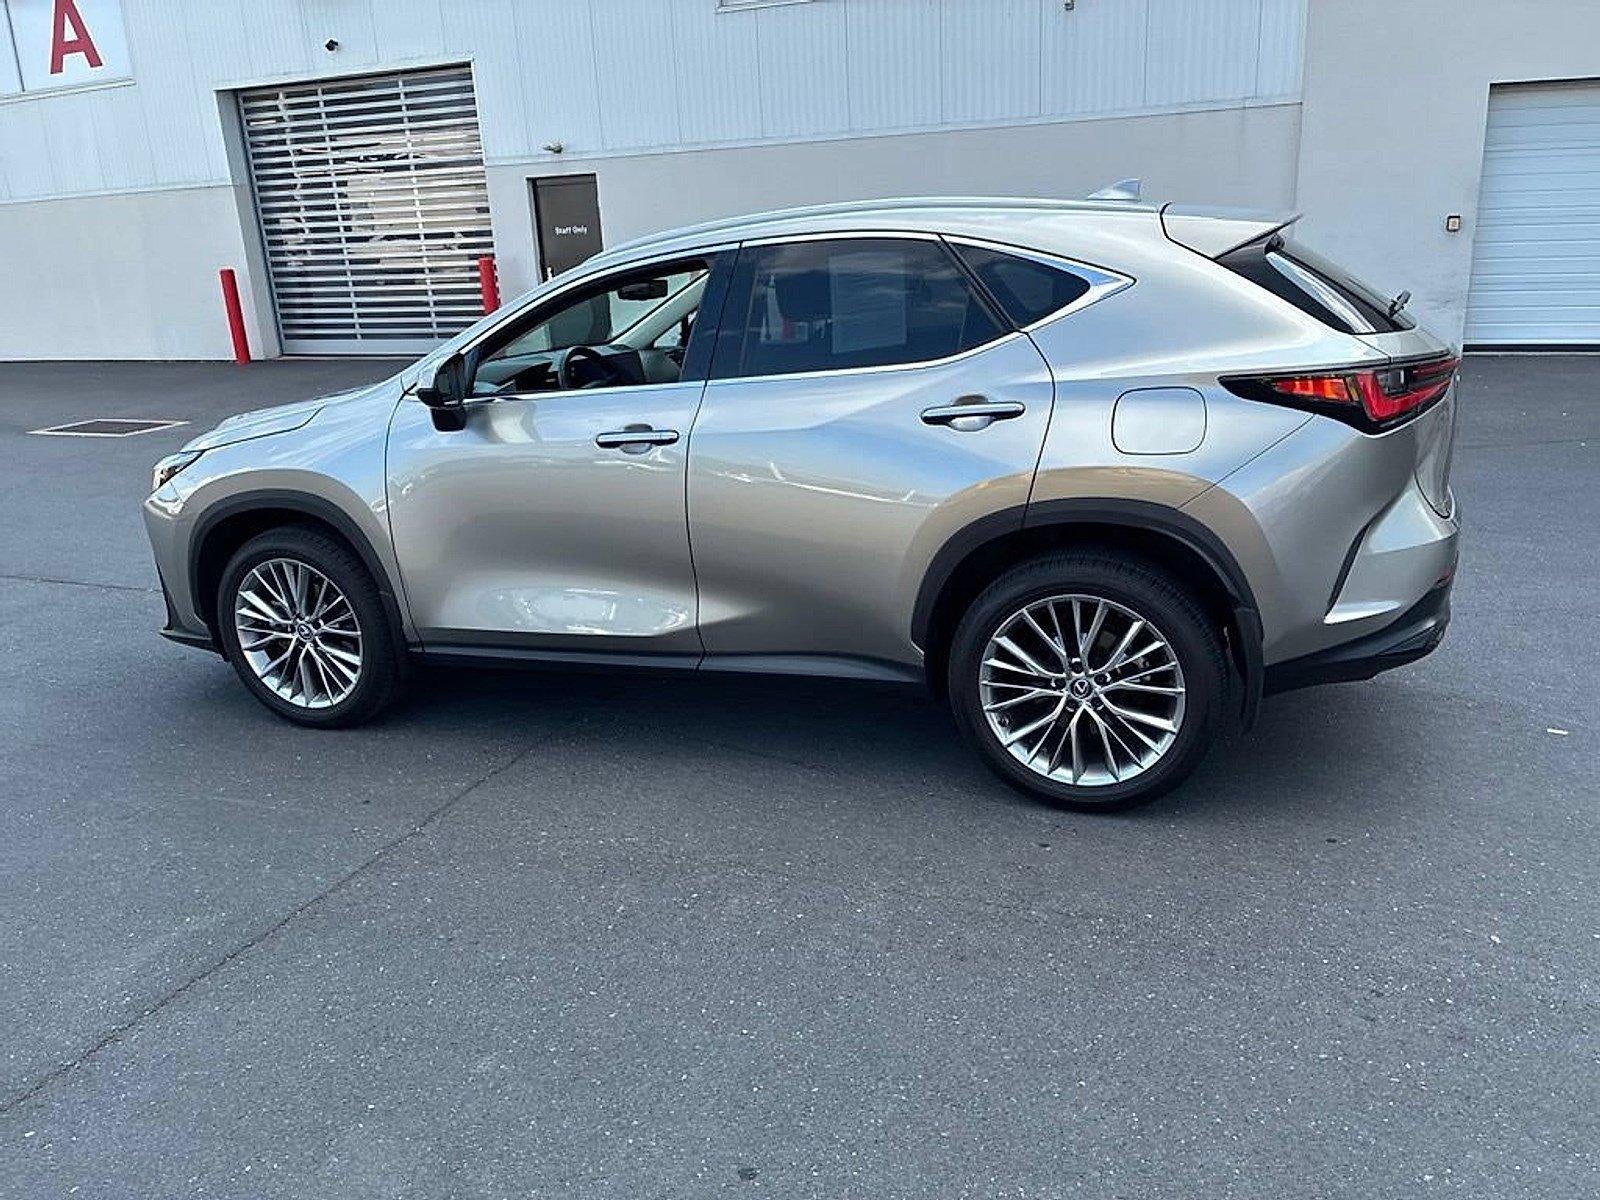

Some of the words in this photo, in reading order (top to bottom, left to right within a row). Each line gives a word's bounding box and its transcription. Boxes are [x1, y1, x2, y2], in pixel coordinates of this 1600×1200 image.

[50, 0, 103, 74] A
[555, 226, 571, 235] Staff
[572, 225, 588, 235] Only
